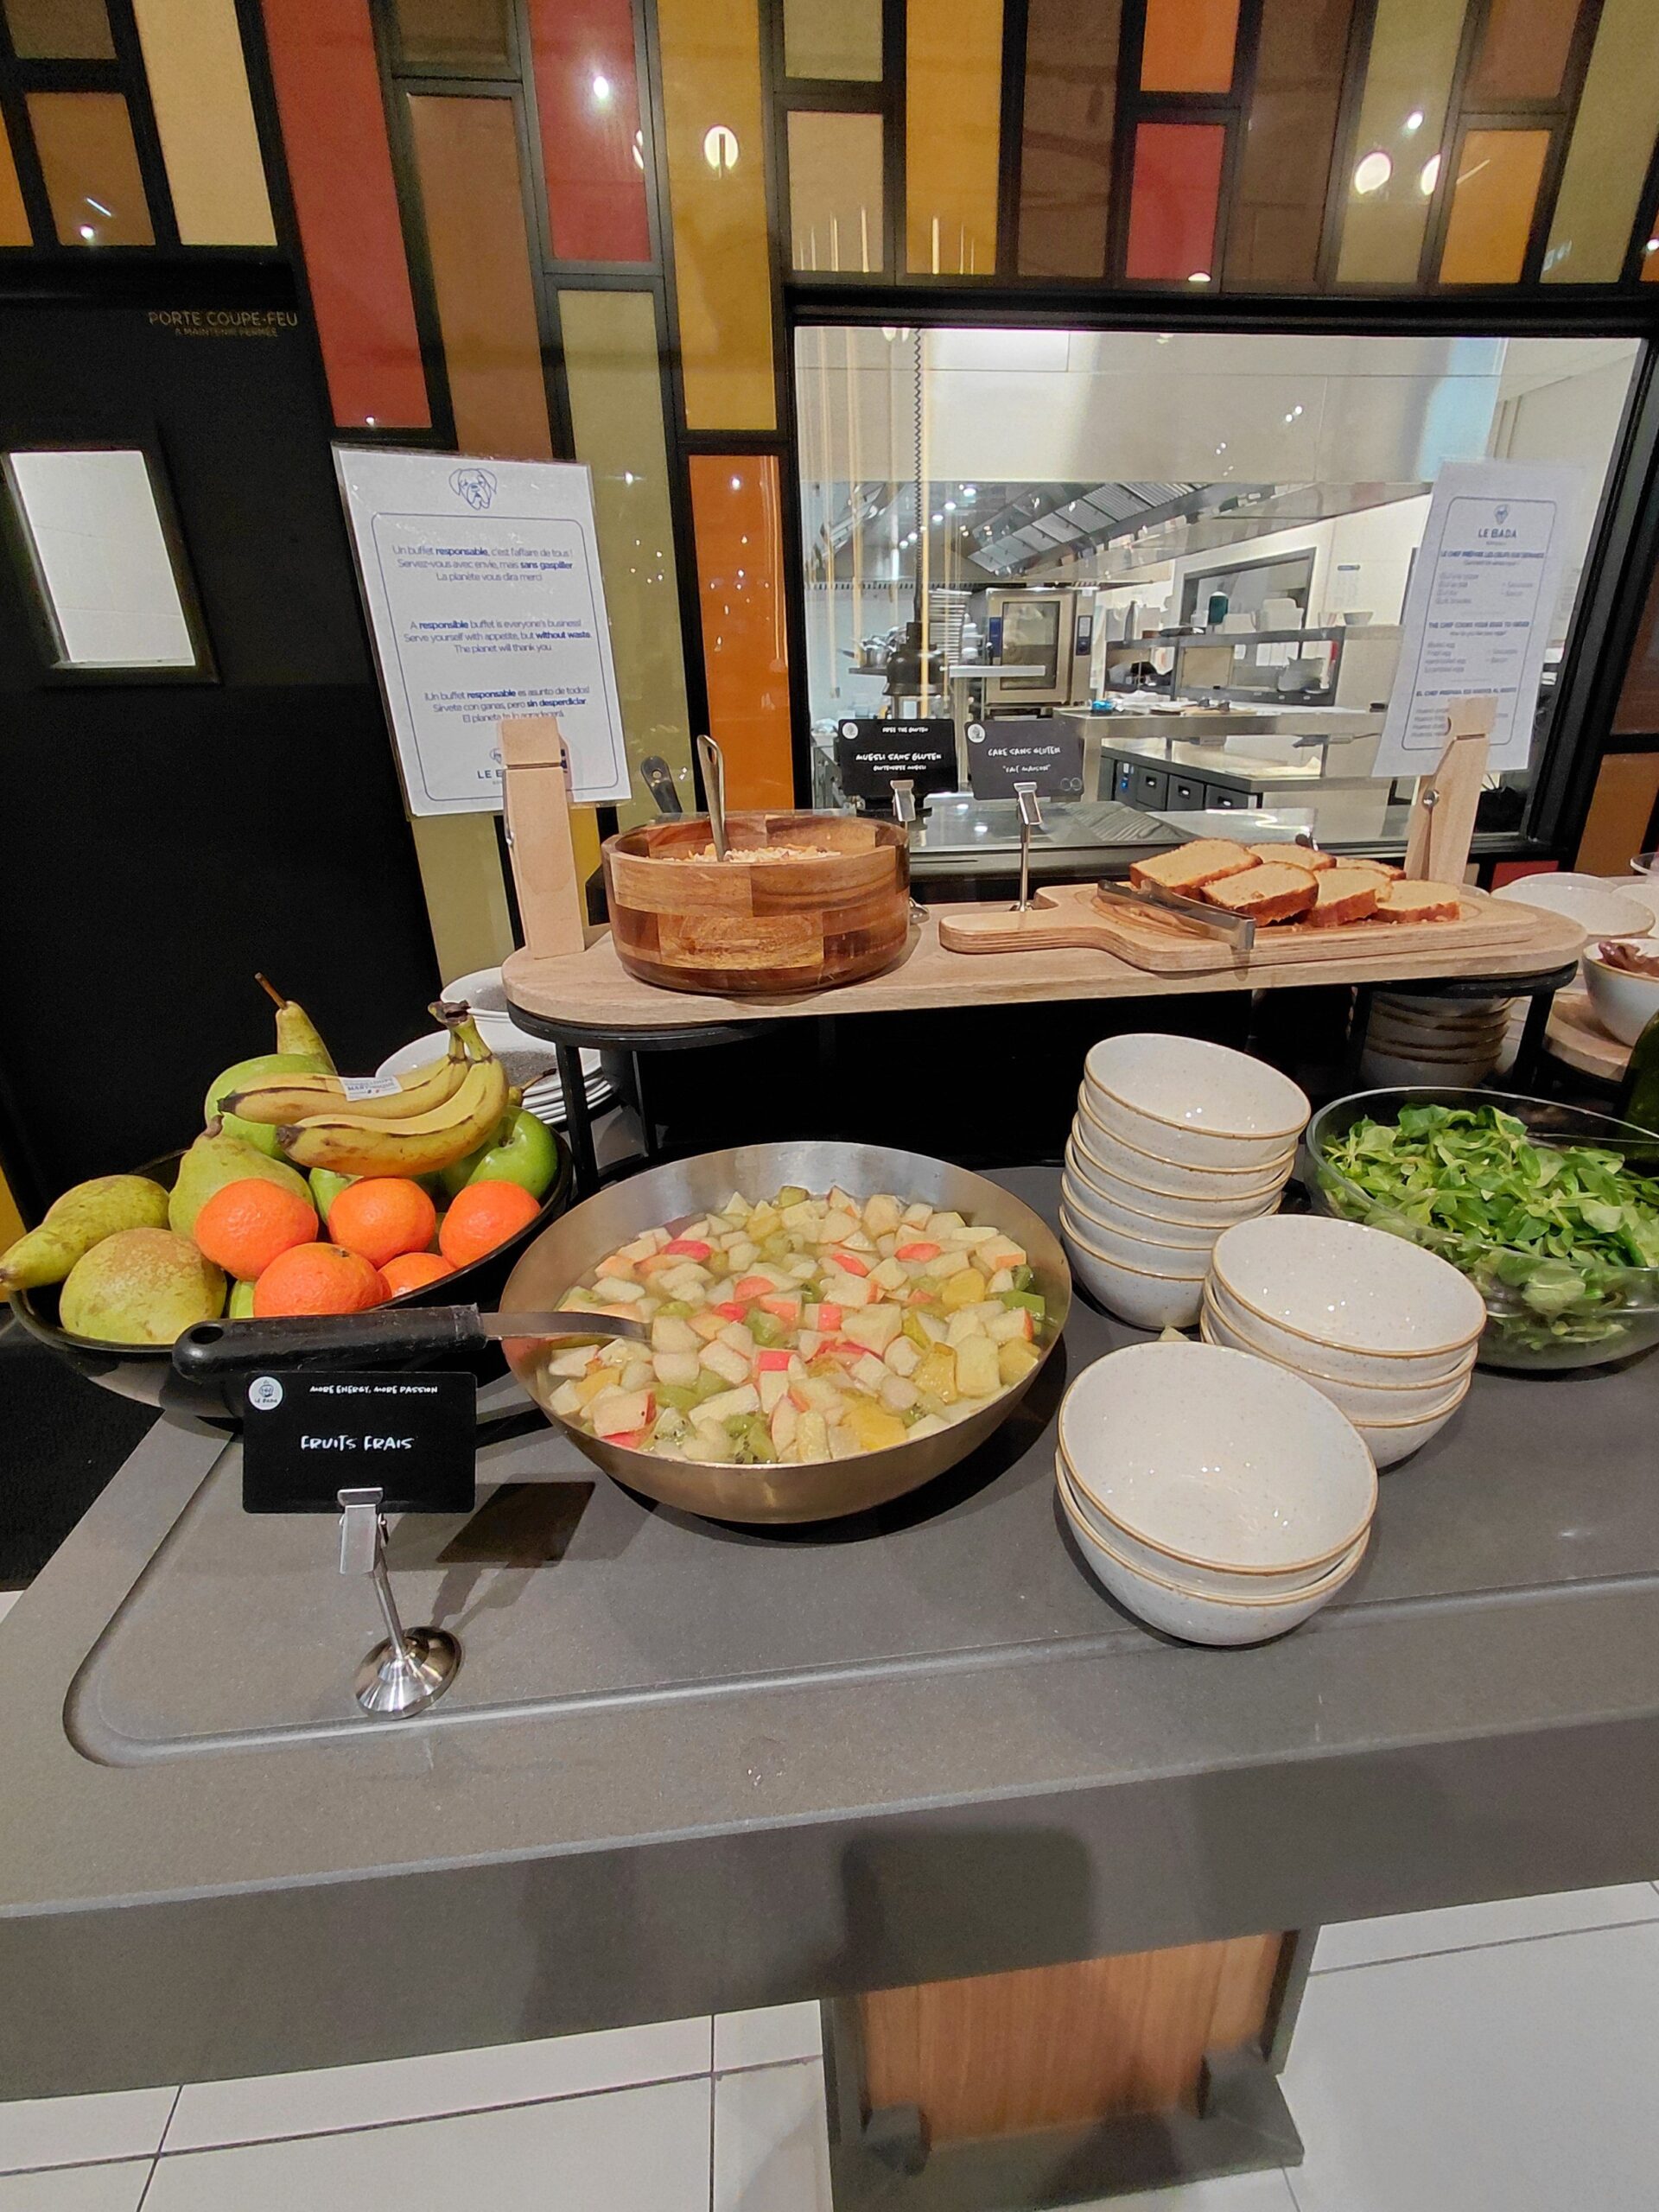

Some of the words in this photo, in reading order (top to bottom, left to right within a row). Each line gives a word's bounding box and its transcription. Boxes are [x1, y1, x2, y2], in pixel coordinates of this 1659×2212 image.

[149, 311, 200, 326] PORTE
[1478, 528, 1488, 537] LE
[391, 545, 406, 555] Un
[407, 545, 433, 555] buffet
[540, 549, 551, 557] de
[551, 549, 569, 557] tous
[435, 572, 448, 581] La
[448, 571, 481, 582] planète
[410, 620, 418, 630] A
[419, 620, 469, 631] responsible
[469, 619, 496, 629] buffet
[404, 632, 430, 643] Serve
[429, 632, 463, 644] yourself
[464, 632, 484, 641] with
[520, 631, 535, 640] but
[535, 631, 566, 639] without
[454, 644, 471, 654] The
[471, 644, 499, 654] planet
[498, 643, 512, 652] will
[512, 643, 535, 652] thank
[440, 690, 466, 700] buffet
[467, 689, 517, 699] responsable
[527, 688, 555, 696] asunto
[506, 702, 526, 710] pero
[526, 698, 538, 708] sin
[462, 714, 472, 723] El
[472, 713, 502, 723] planeta
[855, 753, 886, 761] MUESLI
[887, 753, 912, 761] SANS
[912, 752, 943, 761] GLUTEN
[988, 747, 1008, 757] CAKE
[1008, 747, 1033, 756] SANS
[1033, 746, 1061, 755] GLUTEN
[476, 769, 492, 779] LE
[309, 1385, 335, 1394] MORE
[335, 1385, 372, 1394] ENERGY,
[372, 1385, 398, 1394] MORE
[301, 1435, 358, 1452] FRUITS
[364, 1435, 416, 1452] FRAIS
